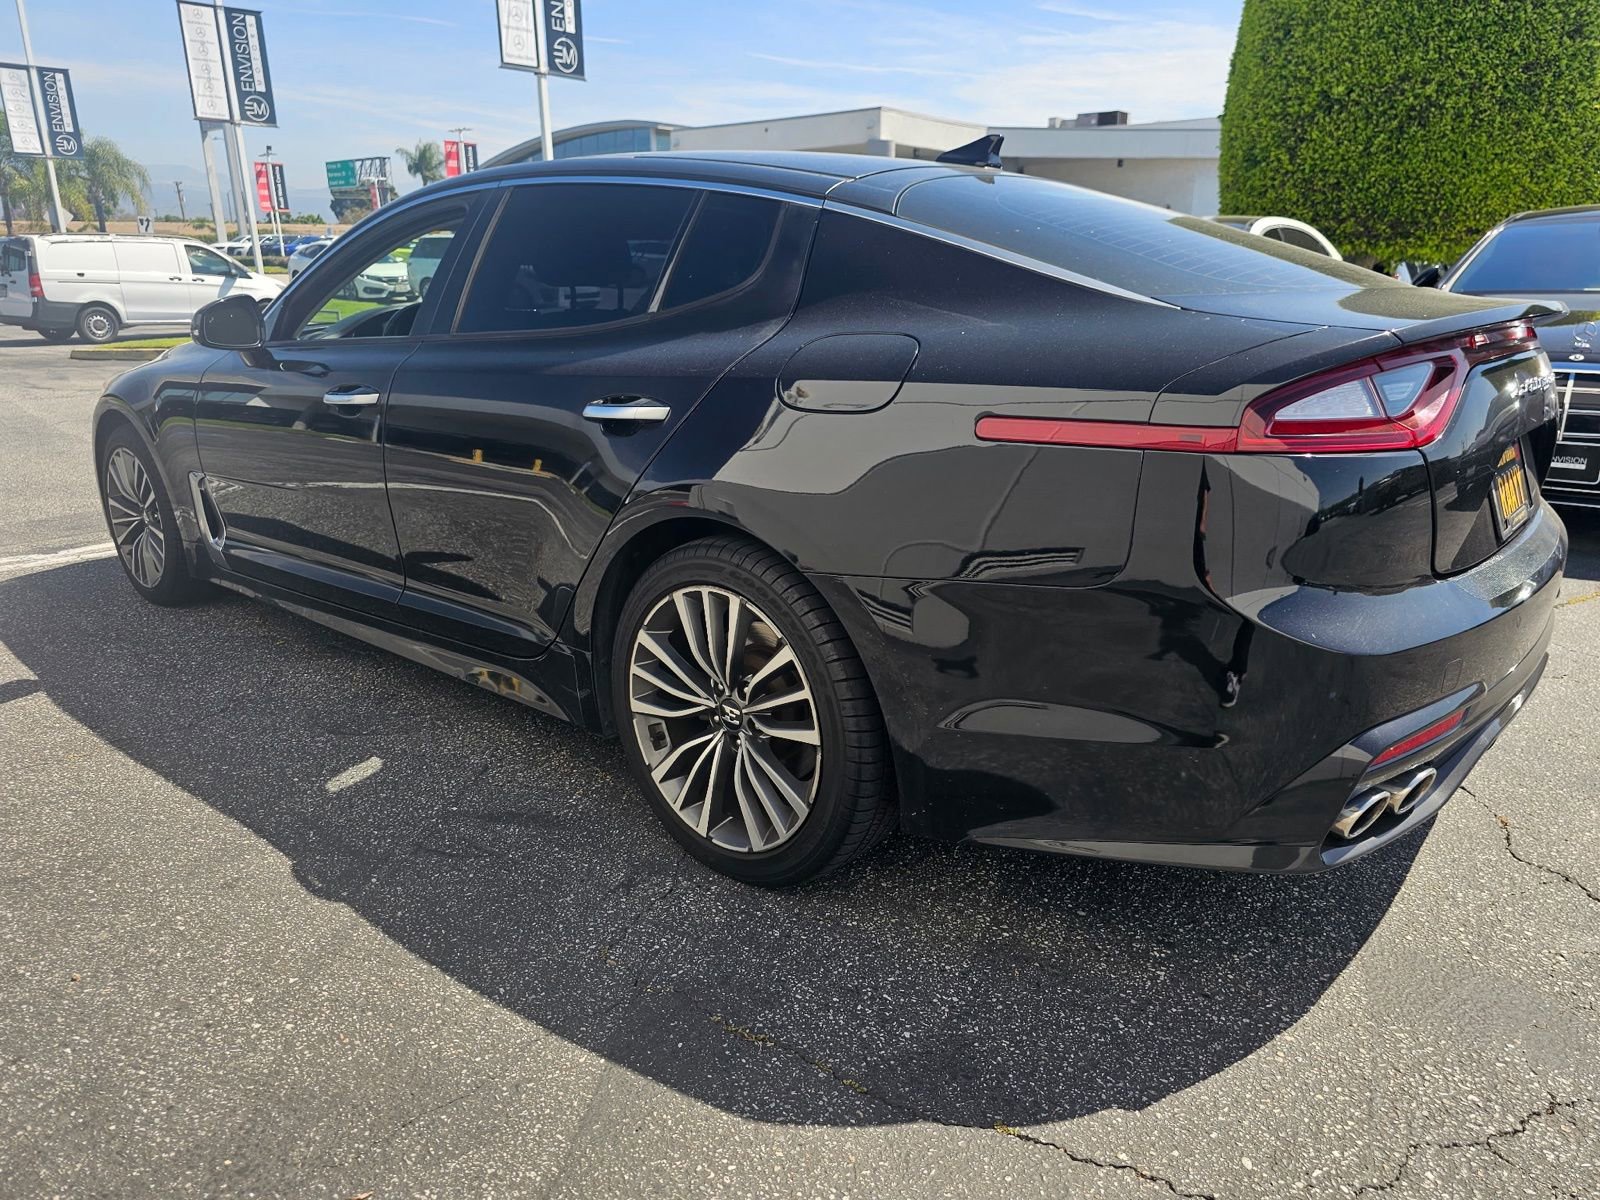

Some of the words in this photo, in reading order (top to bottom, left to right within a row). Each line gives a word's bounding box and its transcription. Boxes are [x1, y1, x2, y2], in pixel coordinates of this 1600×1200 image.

[231, 12, 256, 92] ENVISION
[249, 22, 263, 87] MOTORS
[44, 71, 64, 132] ENVISION
[1551, 455, 1588, 465] NVISION
